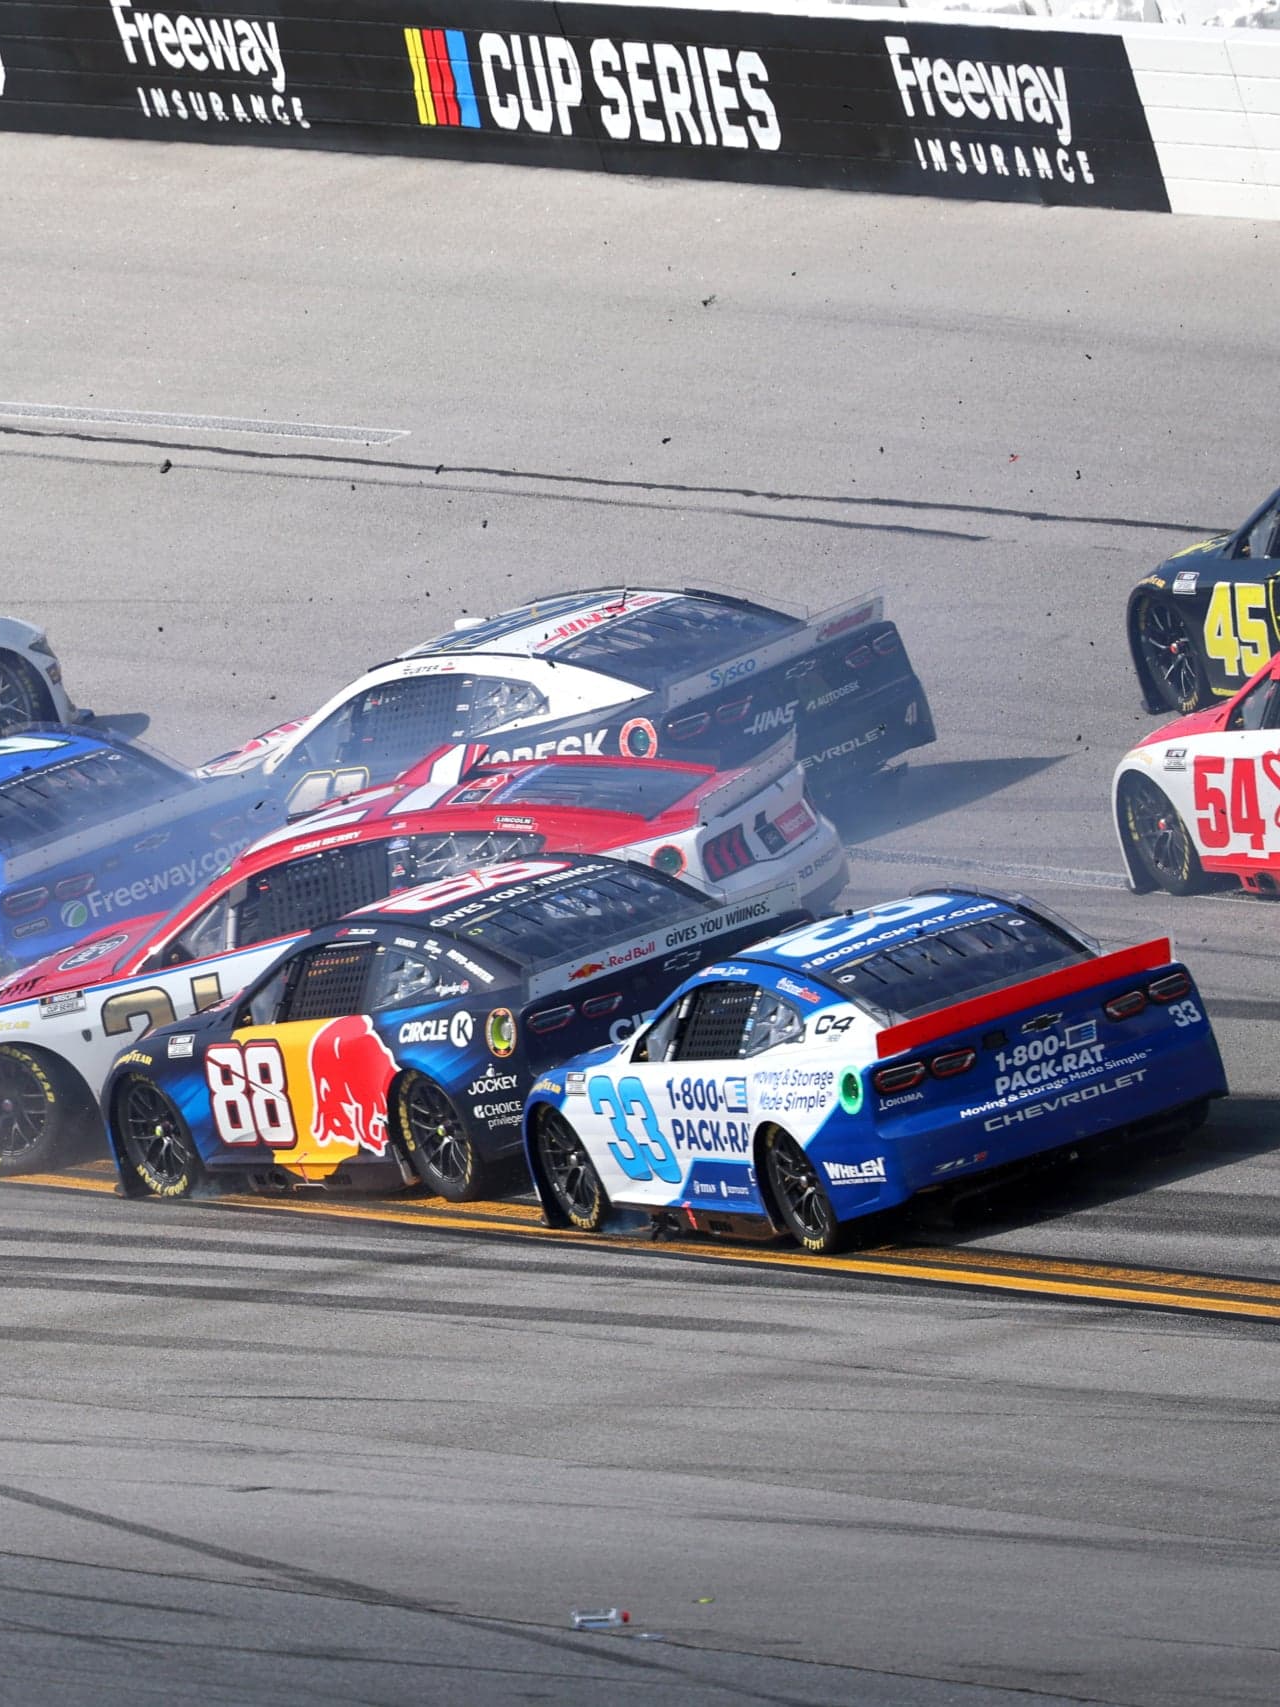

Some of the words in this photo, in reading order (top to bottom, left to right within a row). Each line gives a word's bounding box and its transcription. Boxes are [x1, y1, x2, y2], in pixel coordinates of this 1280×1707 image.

[110, 0, 286, 93] Freeway
[137, 87, 311, 129] INSURANCE
[478, 32, 582, 135] CUP
[590, 38, 781, 151] SERIES
[884, 36, 1072, 145] Freeway
[914, 138, 1095, 184] INSURANCE
[1204, 581, 1270, 677] 45
[743, 699, 800, 737] HAAS
[904, 702, 917, 726] 41
[477, 728, 609, 766] ODESK
[800, 721, 887, 769] EVROLET
[1194, 755, 1266, 851] 54
[86, 836, 252, 918] Freeway.com
[429, 902, 486, 928] GIVES
[483, 885, 526, 903] YOU
[609, 950, 632, 967] Red
[633, 941, 656, 958] Bull
[665, 927, 697, 948] GIVES
[700, 915, 723, 936] YOU
[398, 1021, 450, 1044] CIRCLE
[456, 1020, 470, 1041] K
[815, 1014, 856, 1036] C4
[1168, 1000, 1202, 1027] 33
[468, 1075, 518, 1096] JOCKEY
[782, 1068, 790, 1085] &
[790, 1069, 834, 1090] Storage
[960, 1097, 1007, 1119] Moving
[1007, 1093, 1019, 1103] &
[1018, 1077, 1069, 1099] Storage
[1069, 1065, 1104, 1082] Made
[995, 1044, 1106, 1096] PACK-RAT
[204, 1039, 298, 1151] 88
[484, 1100, 523, 1117] CHOICE
[984, 1069, 1149, 1132] CHEVROLET
[488, 1114, 524, 1130] privilege
[588, 1075, 682, 1183] 33
[671, 1119, 750, 1153] PACK-RA
[823, 1156, 885, 1181] WHELEN
